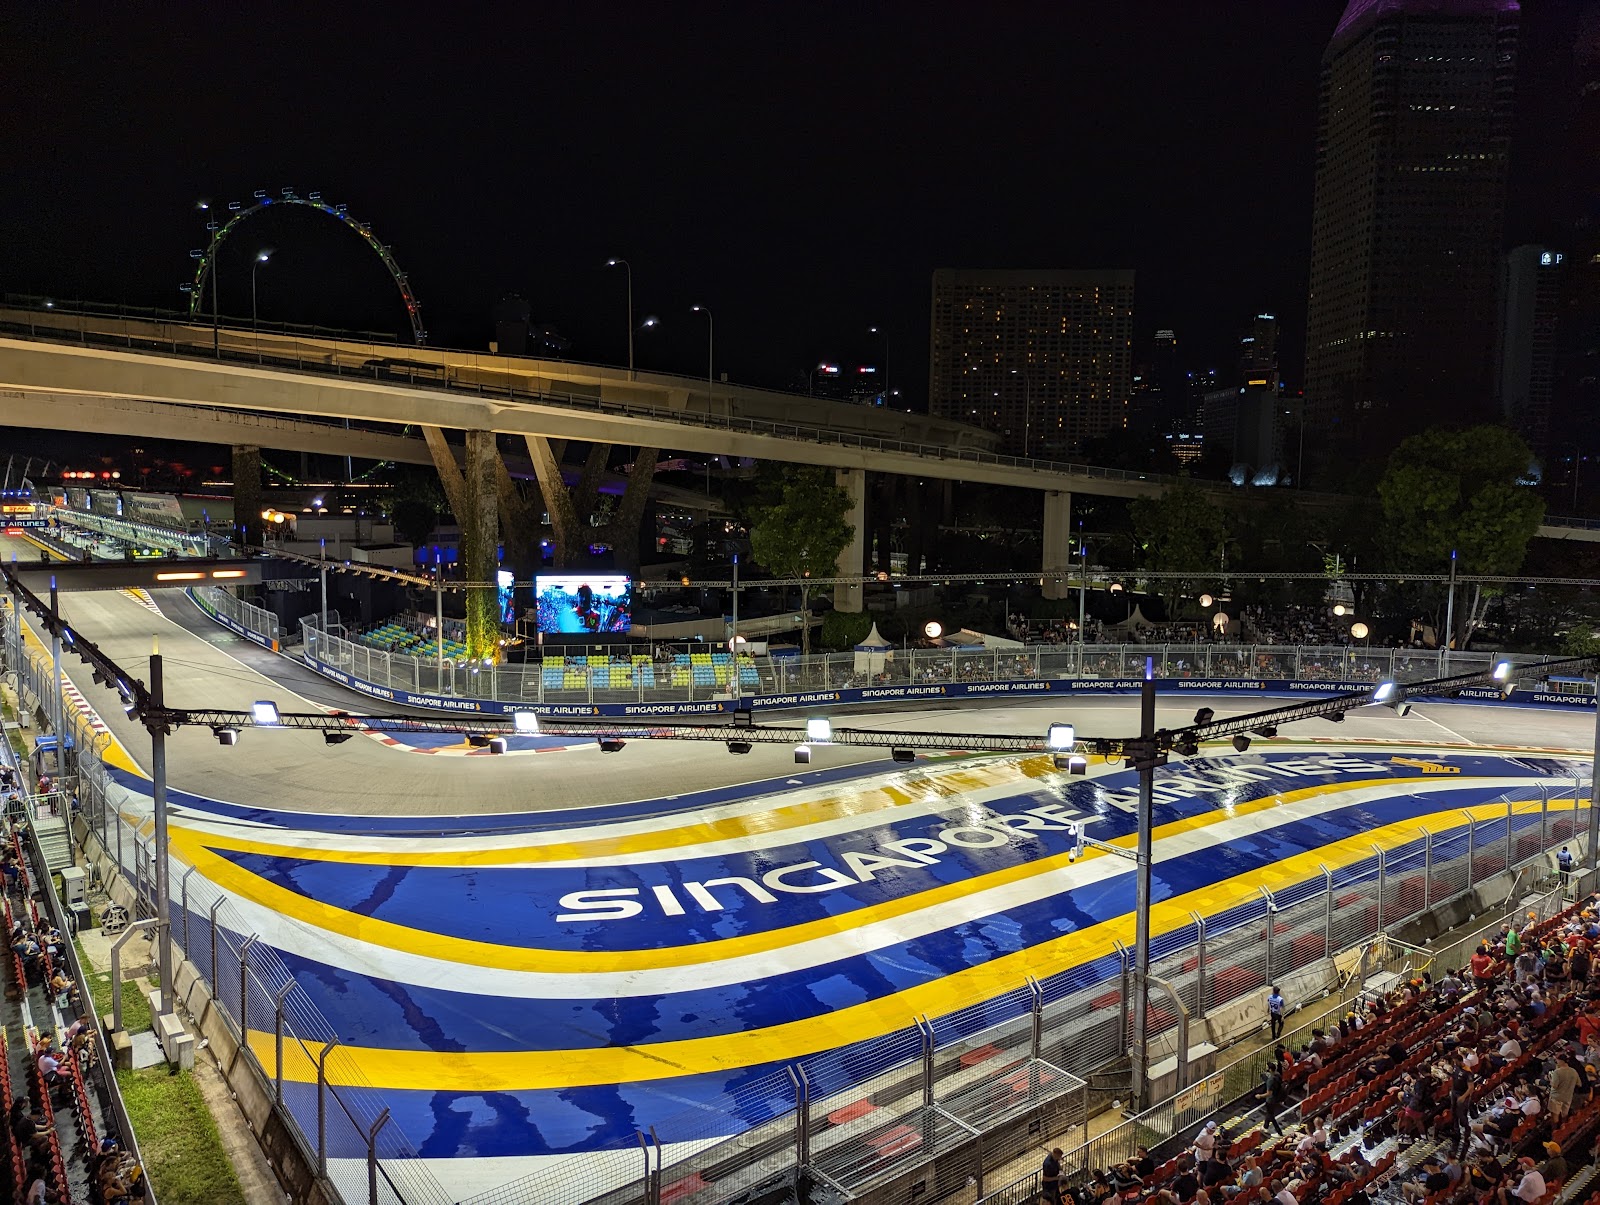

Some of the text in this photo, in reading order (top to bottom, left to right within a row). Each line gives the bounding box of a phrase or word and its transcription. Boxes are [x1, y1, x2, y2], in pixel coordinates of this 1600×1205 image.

[967, 682, 1045, 692] SINGAPORE AIRLINES
[1071, 681, 1114, 689] SINGAPORE
[1289, 682, 1336, 691] SINGAPORE
[862, 686, 941, 697] SINGAPORE AIRLINES
[1458, 689, 1500, 699] AIRLINES
[407, 695, 475, 710] SINGAPORE AIRLINES
[752, 693, 834, 706] SINGAPORE AIRLINES
[1533, 694, 1588, 705] SINGAPORE
[553, 706, 592, 714] AIRLINES
[625, 703, 717, 714] SINGAPORE AIRLINES
[556, 756, 1390, 923] SINGAPORE AIRLINES
